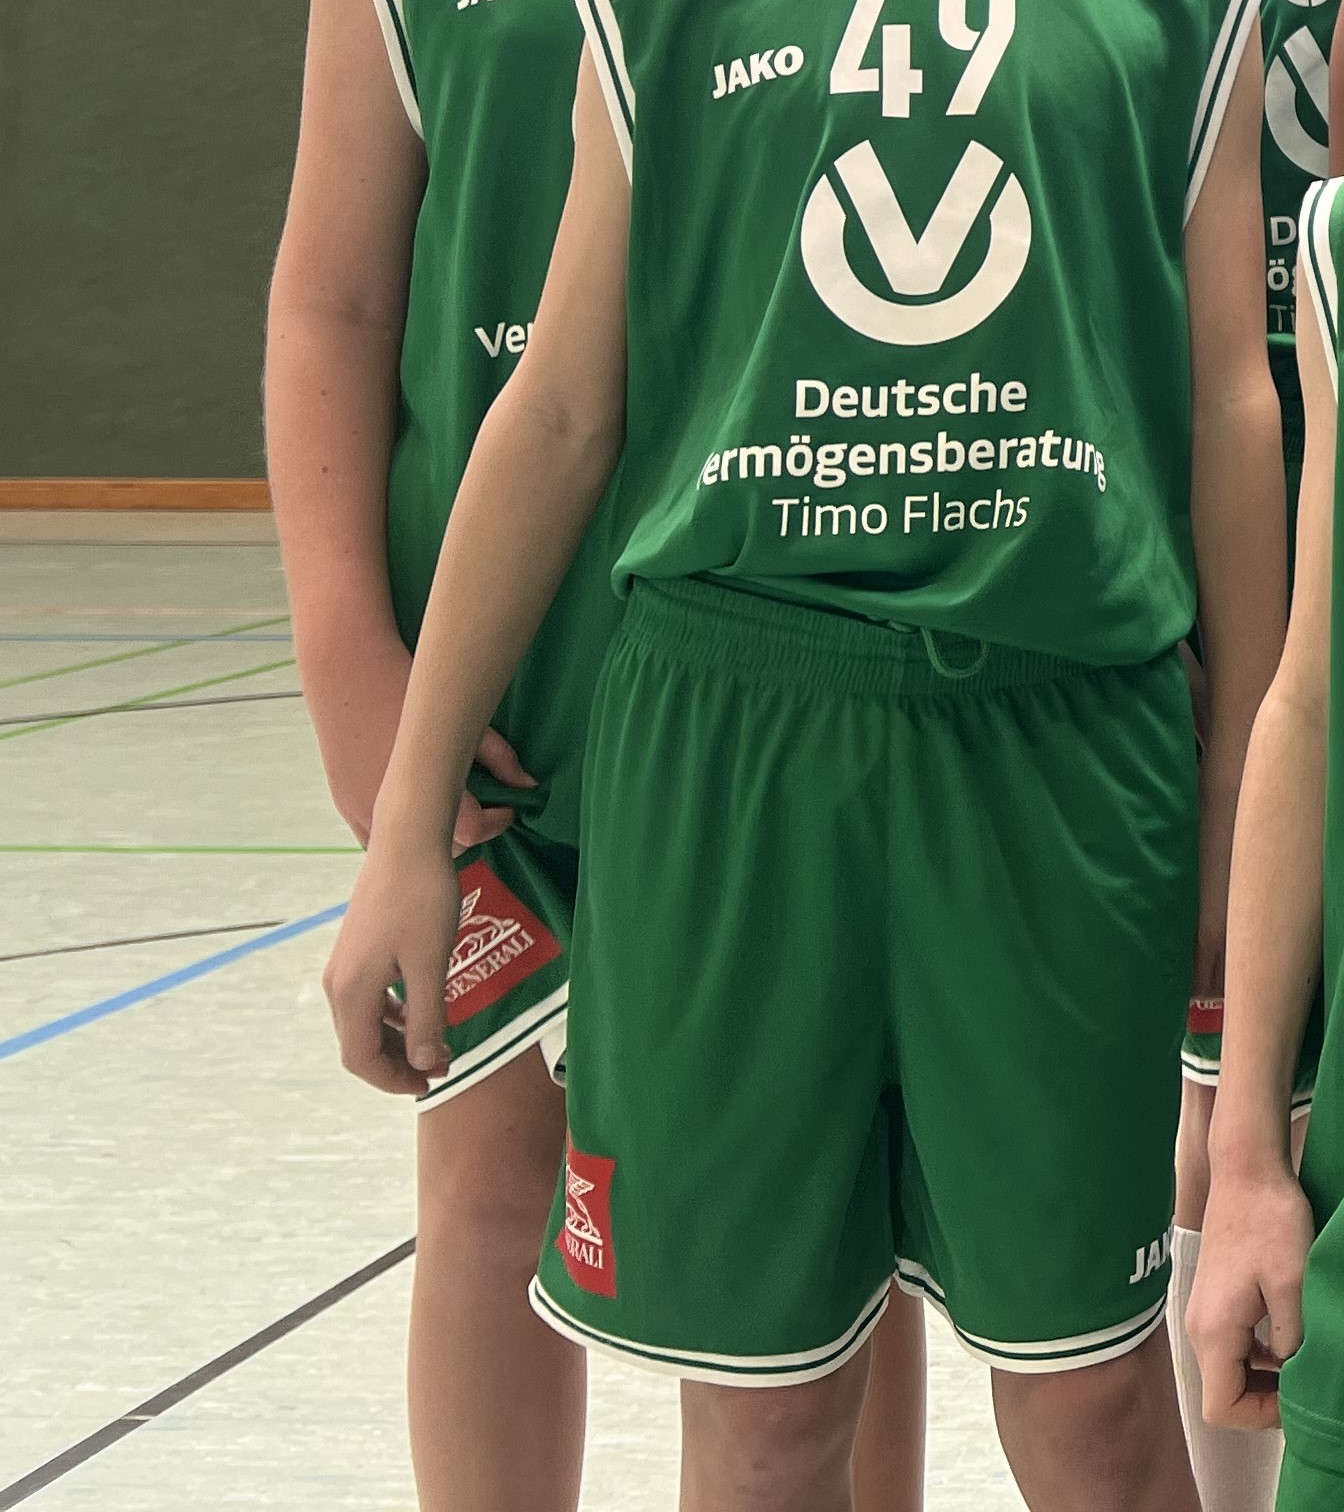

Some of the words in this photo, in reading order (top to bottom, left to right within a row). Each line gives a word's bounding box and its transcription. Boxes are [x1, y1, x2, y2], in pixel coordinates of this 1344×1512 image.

[712, 45, 804, 100] JAKO
[795, 372, 1028, 419] Deutsche
[772, 496, 888, 537] Timo
[903, 489, 1031, 534] Flachs
